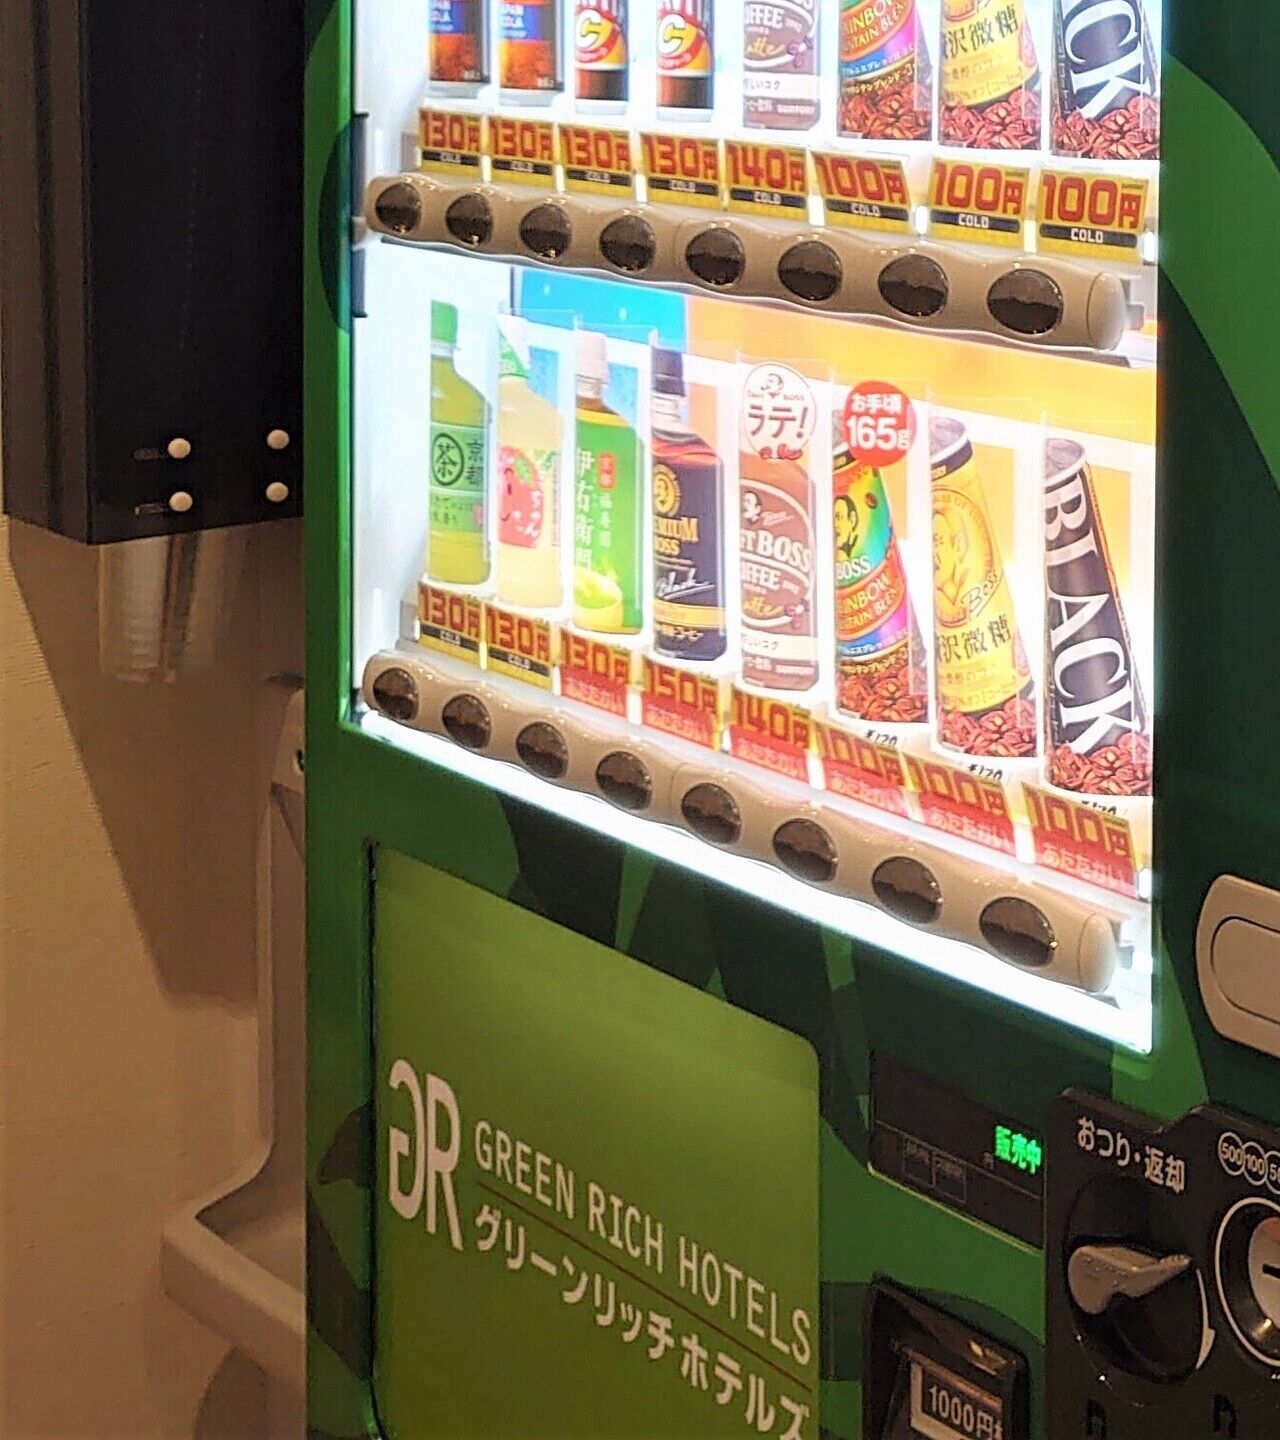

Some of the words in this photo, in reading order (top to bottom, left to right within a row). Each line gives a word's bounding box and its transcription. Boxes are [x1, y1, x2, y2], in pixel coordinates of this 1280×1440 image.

[727, 142, 805, 191] 140円
[815, 153, 907, 204] 100円
[933, 159, 1023, 215] 100円
[850, 203, 881, 218] COLD
[958, 213, 990, 230] COLD
[1041, 173, 1142, 230] 100円
[1070, 228, 1104, 244] COLD
[758, 531, 812, 571] BOSS
[1045, 471, 1140, 754] BLACK
[994, 1125, 1042, 1175] 販売中
[1077, 1116, 1186, 1195] おつり・返却
[1220, 1141, 1244, 1166] 500
[1244, 1149, 1266, 1177] 100
[474, 1120, 576, 1220] GREEN
[587, 1181, 665, 1274] RICH
[678, 1234, 811, 1366] HOTELS
[474, 1203, 811, 1440] グリーンリッチホテルズ
